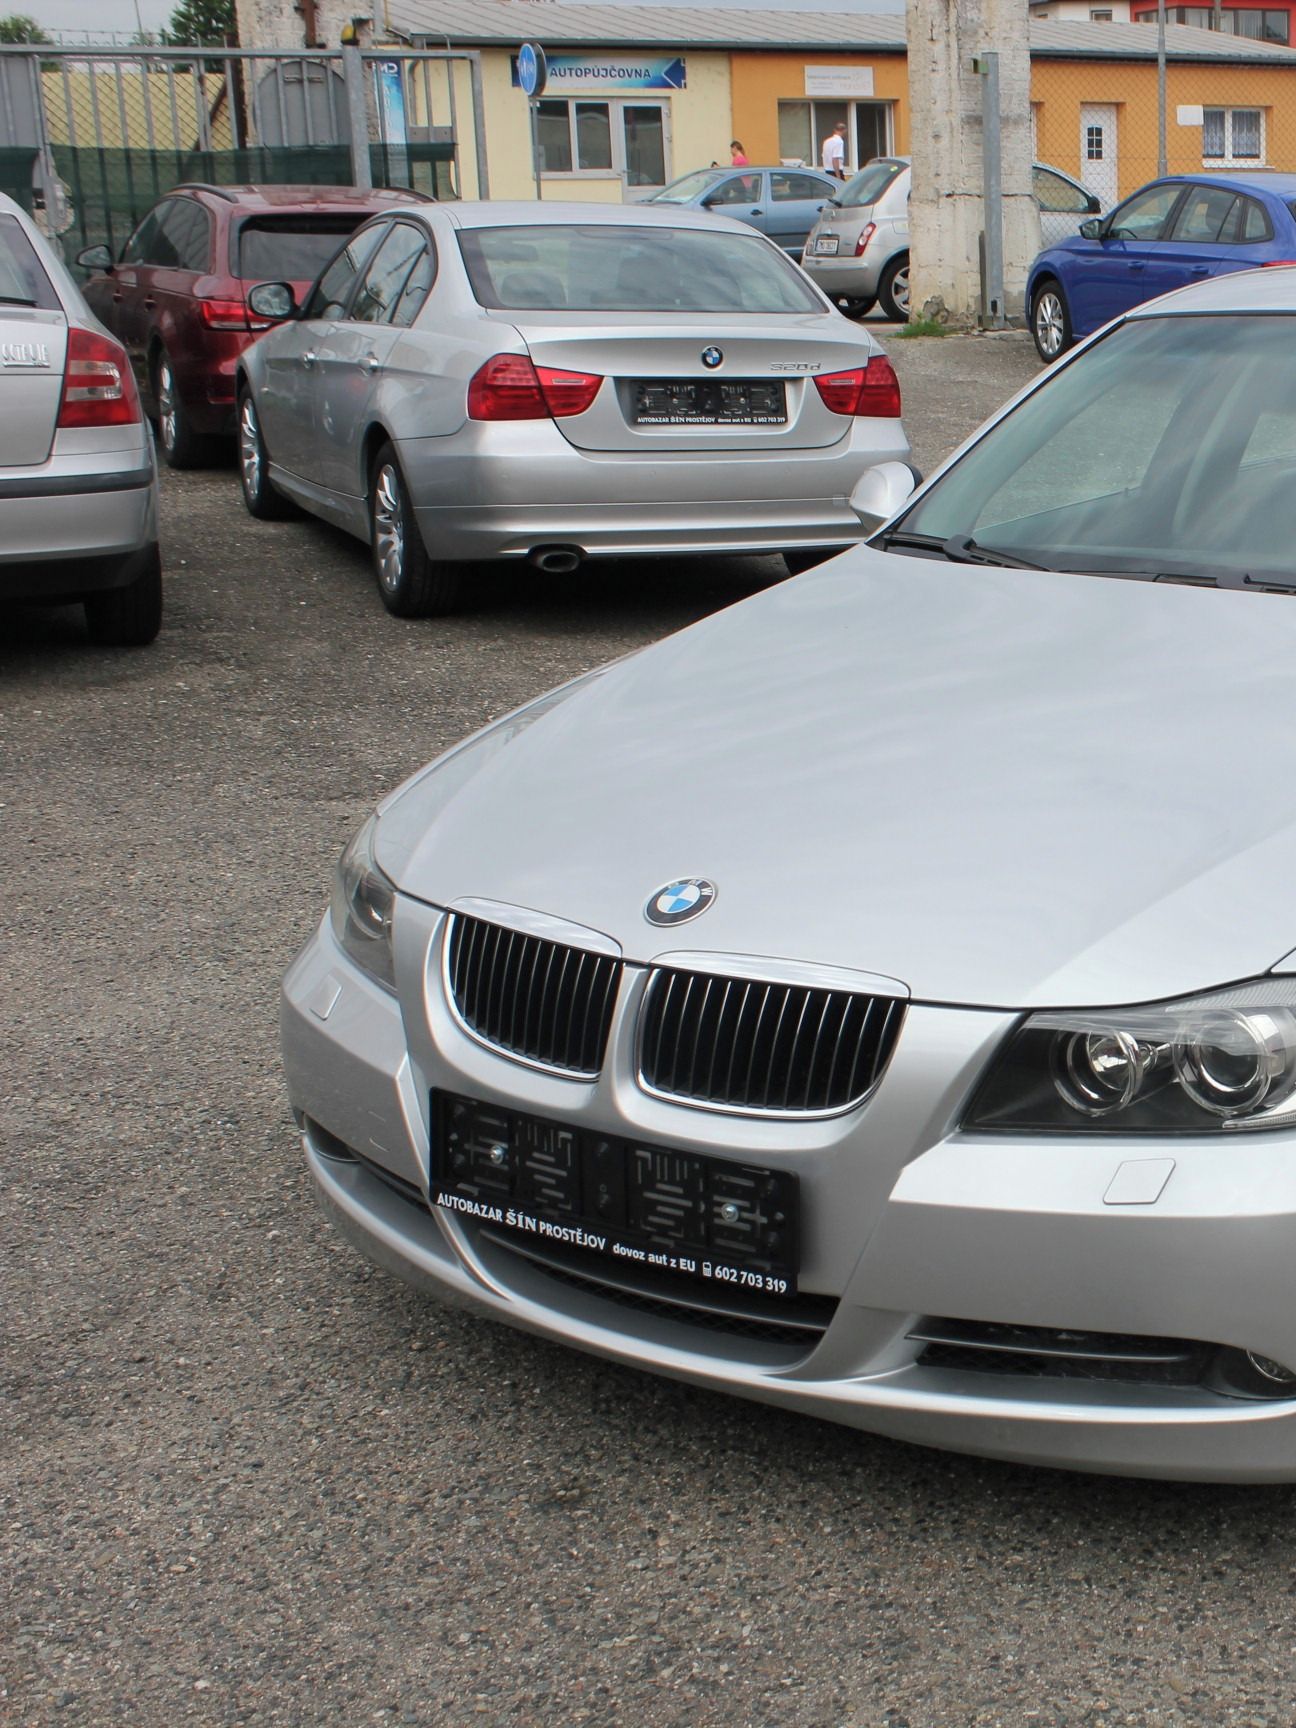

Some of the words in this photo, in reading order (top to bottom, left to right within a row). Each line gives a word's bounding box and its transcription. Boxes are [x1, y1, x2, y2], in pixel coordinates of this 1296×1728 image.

[769, 362, 822, 372] 320d
[437, 1192, 503, 1223] AUTOBAZAR
[506, 1208, 537, 1232] ŠÍN
[539, 1220, 606, 1250] PROSTĚJOV
[613, 1242, 645, 1261] dovoz
[648, 1253, 668, 1266] aut
[670, 1258, 677, 1268] z
[679, 1257, 696, 1272] EU
[715, 1265, 738, 1283] 602
[740, 1271, 763, 1288] 703
[765, 1277, 787, 1294] 319
